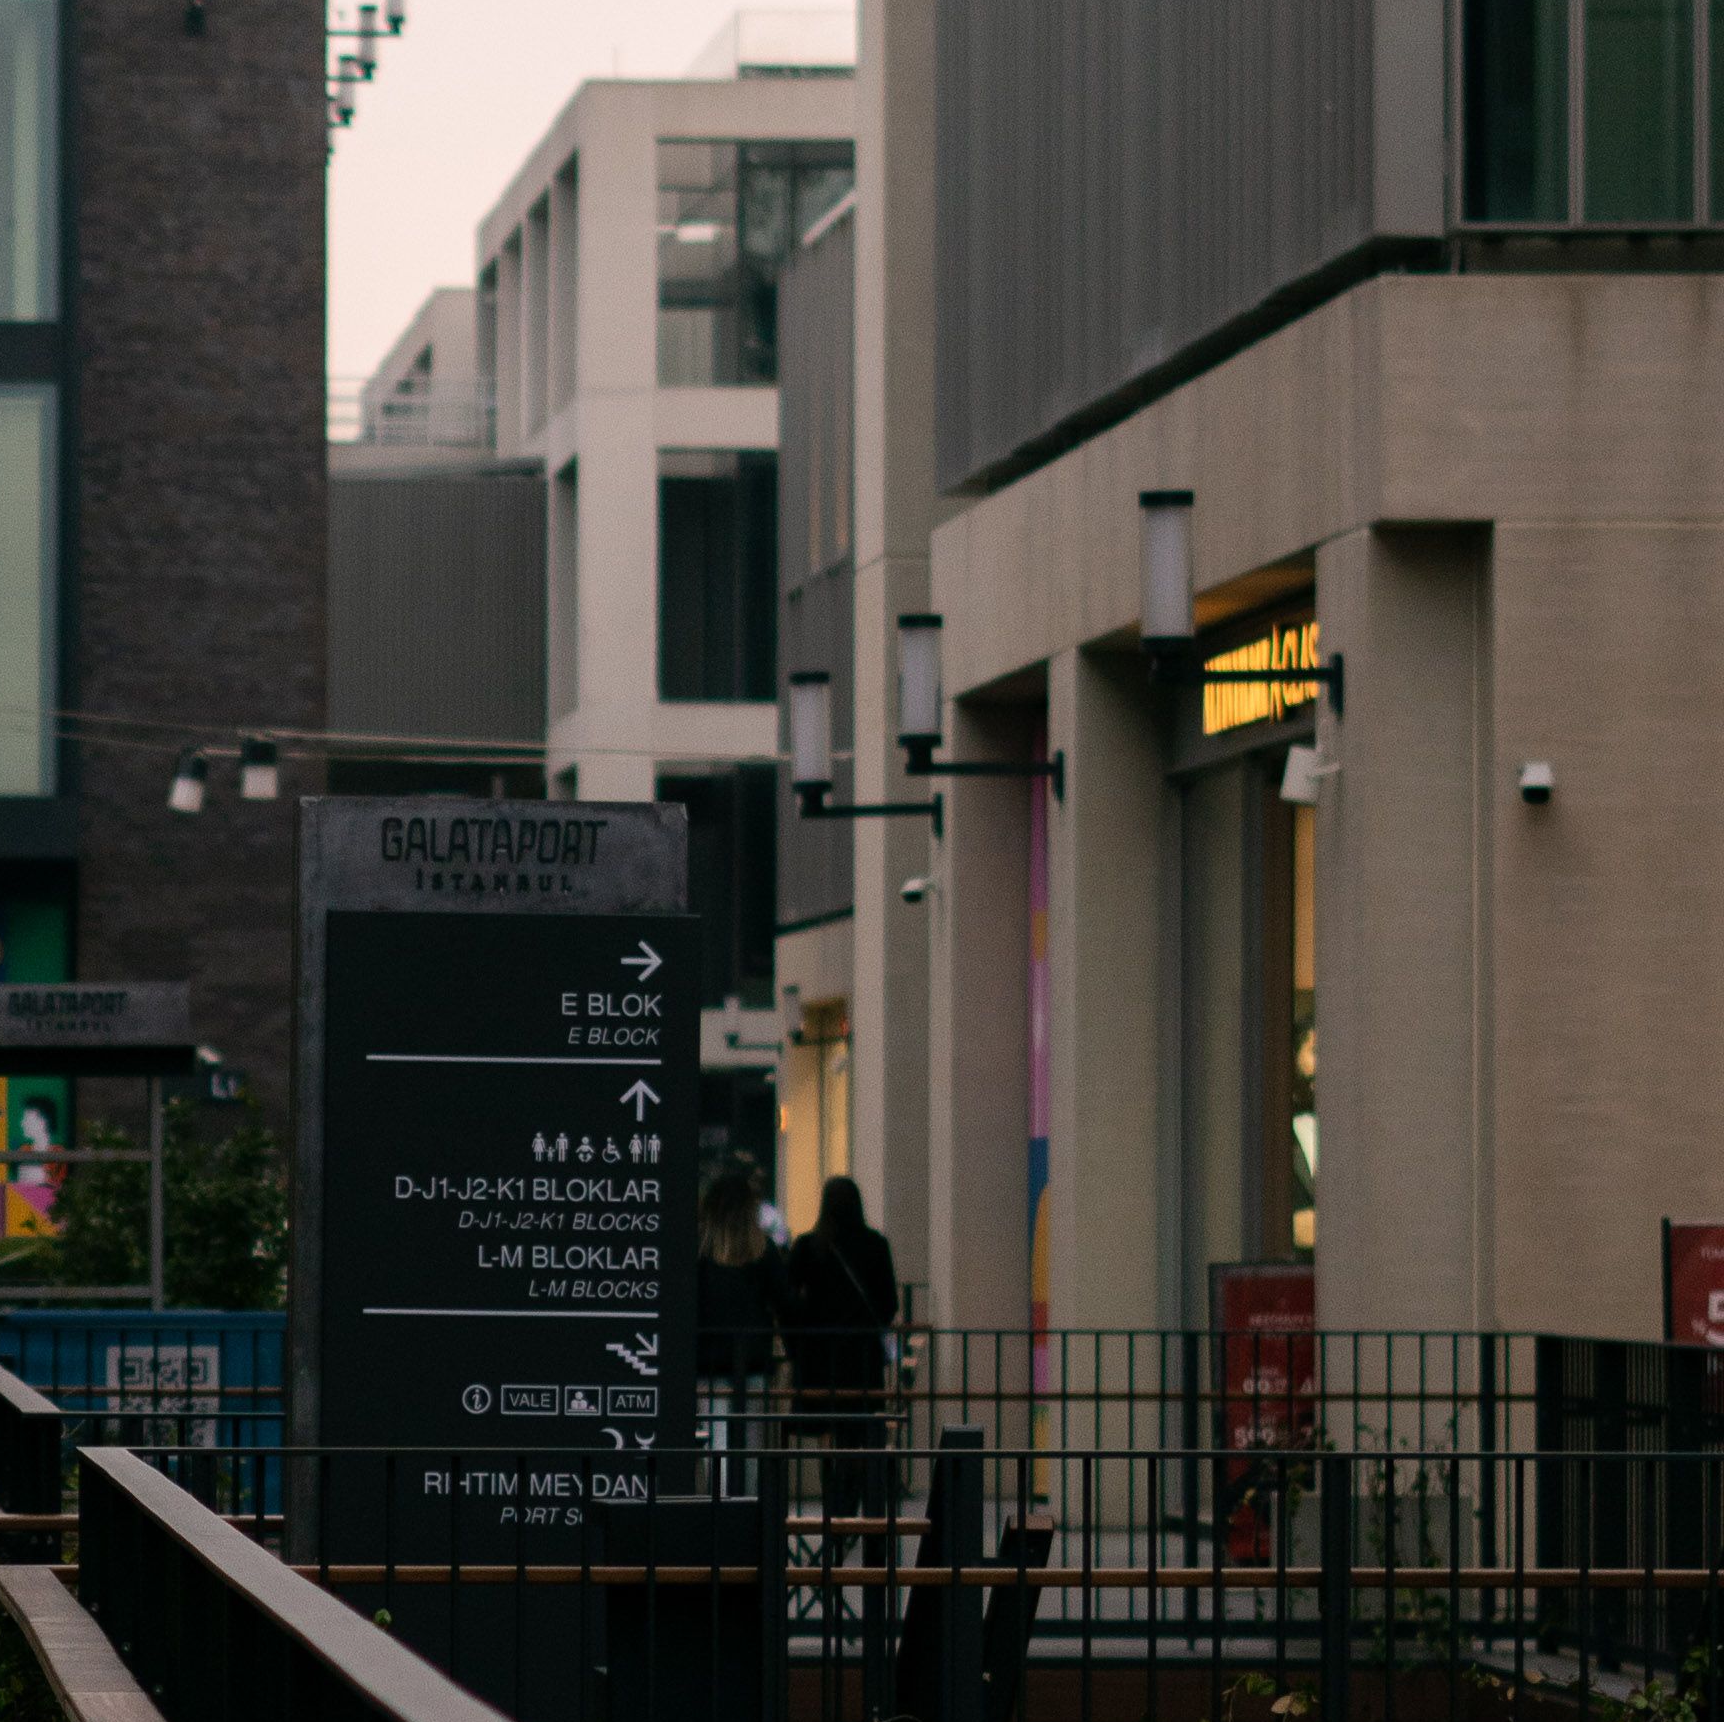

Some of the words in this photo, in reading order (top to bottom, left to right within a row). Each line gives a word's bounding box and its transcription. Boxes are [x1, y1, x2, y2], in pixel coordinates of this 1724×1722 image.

[381, 816, 607, 864] GALATAPORT
[561, 992, 578, 1016] E
[587, 992, 662, 1017] BLOK
[567, 1027, 583, 1045] E
[587, 1027, 660, 1046] BLOCK
[394, 1175, 525, 1200] D-J1-J2-K1
[532, 1178, 661, 1203] BLOKLAR
[458, 1210, 565, 1230] D-J1-J2-K1
[572, 1212, 660, 1232] BLOCKS
[477, 1244, 524, 1268] L-M
[531, 1245, 660, 1270] BLOKLAR
[528, 1279, 566, 1298] L-M
[571, 1280, 660, 1299] BLOCKS
[508, 1392, 551, 1408] VALE
[615, 1393, 651, 1409] ATM
[529, 1472, 658, 1498] MEYDAN
